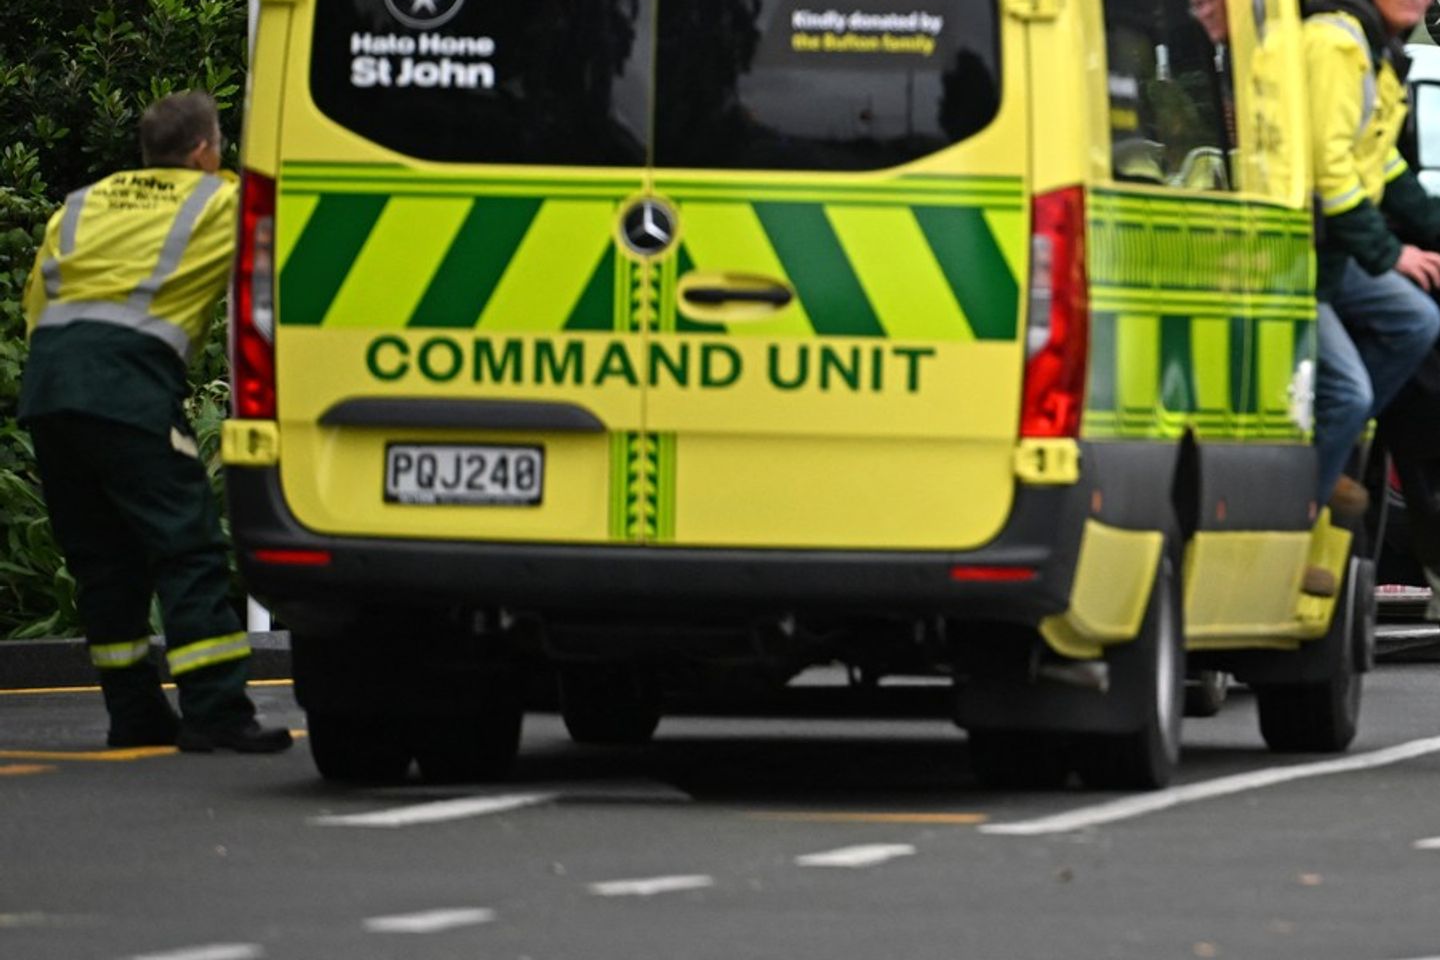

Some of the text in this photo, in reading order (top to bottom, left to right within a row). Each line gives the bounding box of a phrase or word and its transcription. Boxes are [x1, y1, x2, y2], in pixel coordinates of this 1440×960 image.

[350, 32, 495, 57] Hato Hone
[350, 55, 495, 88] St John
[365, 335, 936, 394] COMMAND UNIT
